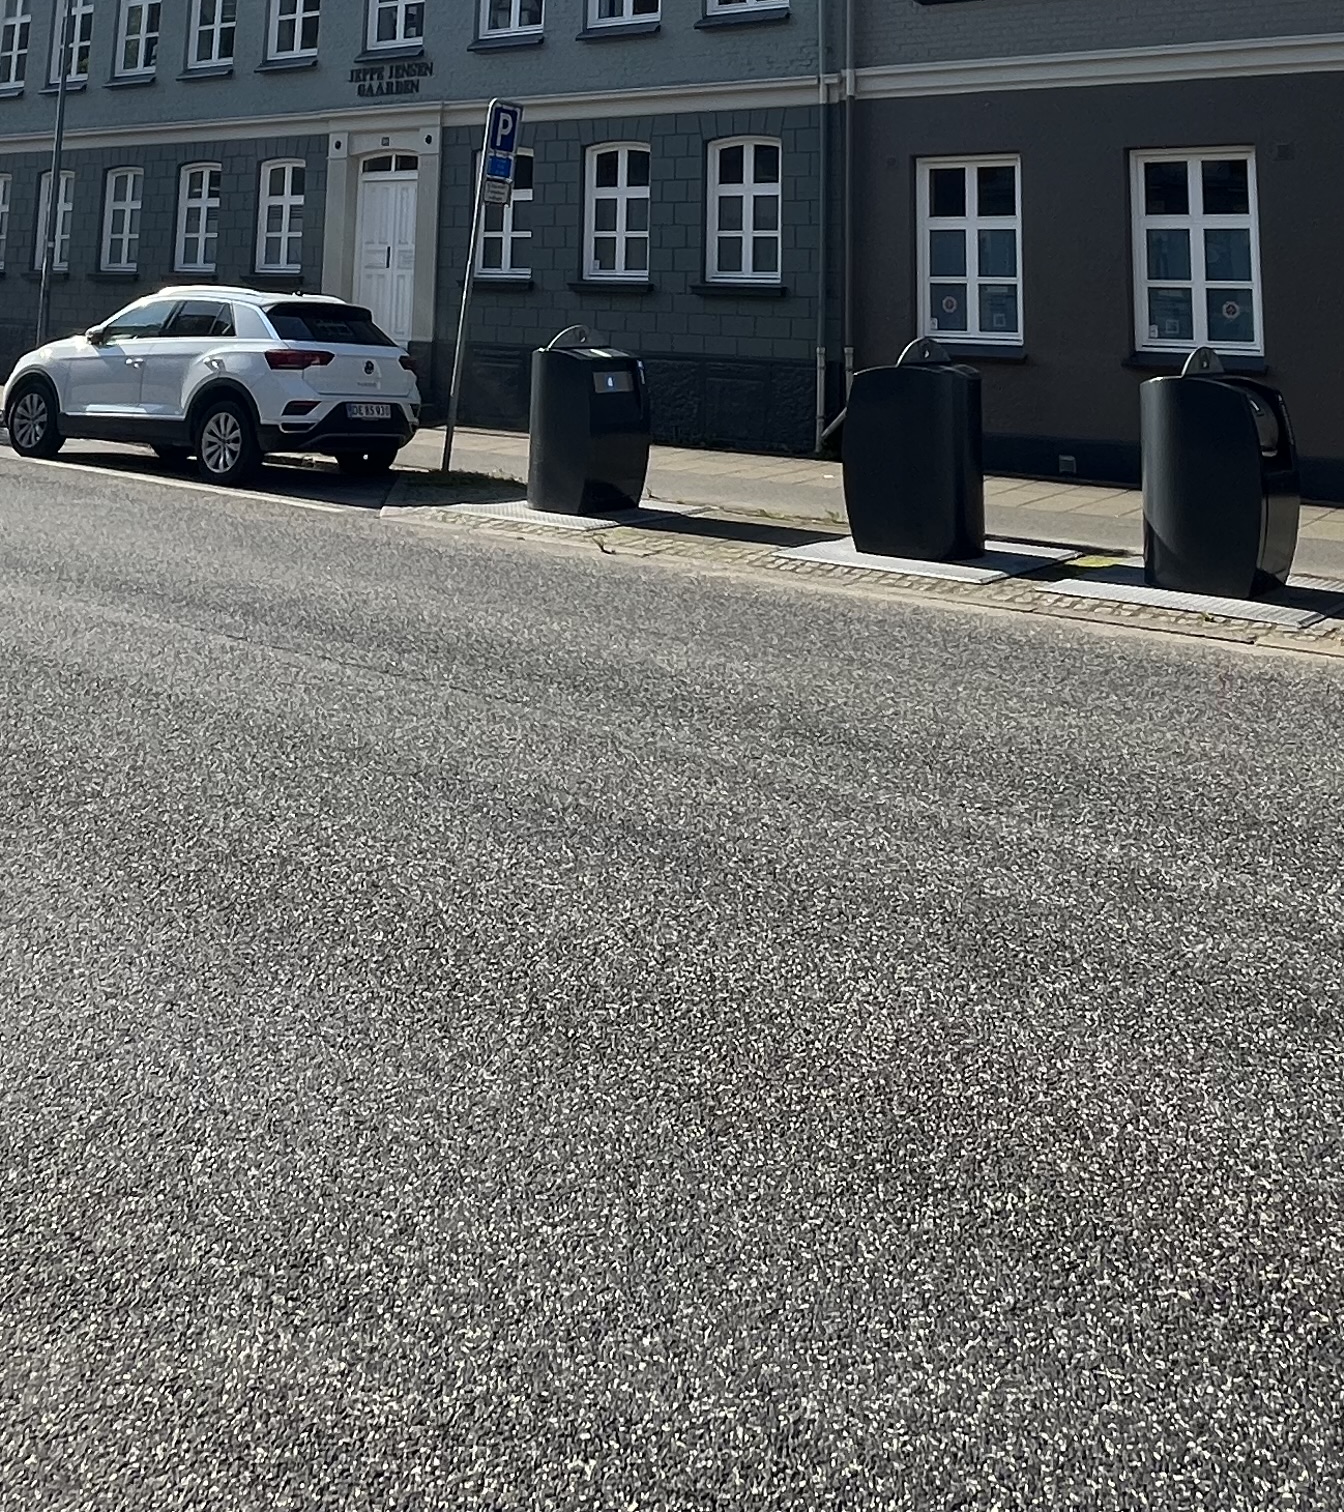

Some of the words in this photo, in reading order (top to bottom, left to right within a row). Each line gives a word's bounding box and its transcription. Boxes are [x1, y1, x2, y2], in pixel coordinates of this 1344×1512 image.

[348, 67, 385, 83] JEPPE
[388, 62, 434, 79] JENSEN
[357, 79, 420, 97] GAARDEN
[496, 112, 513, 147] P
